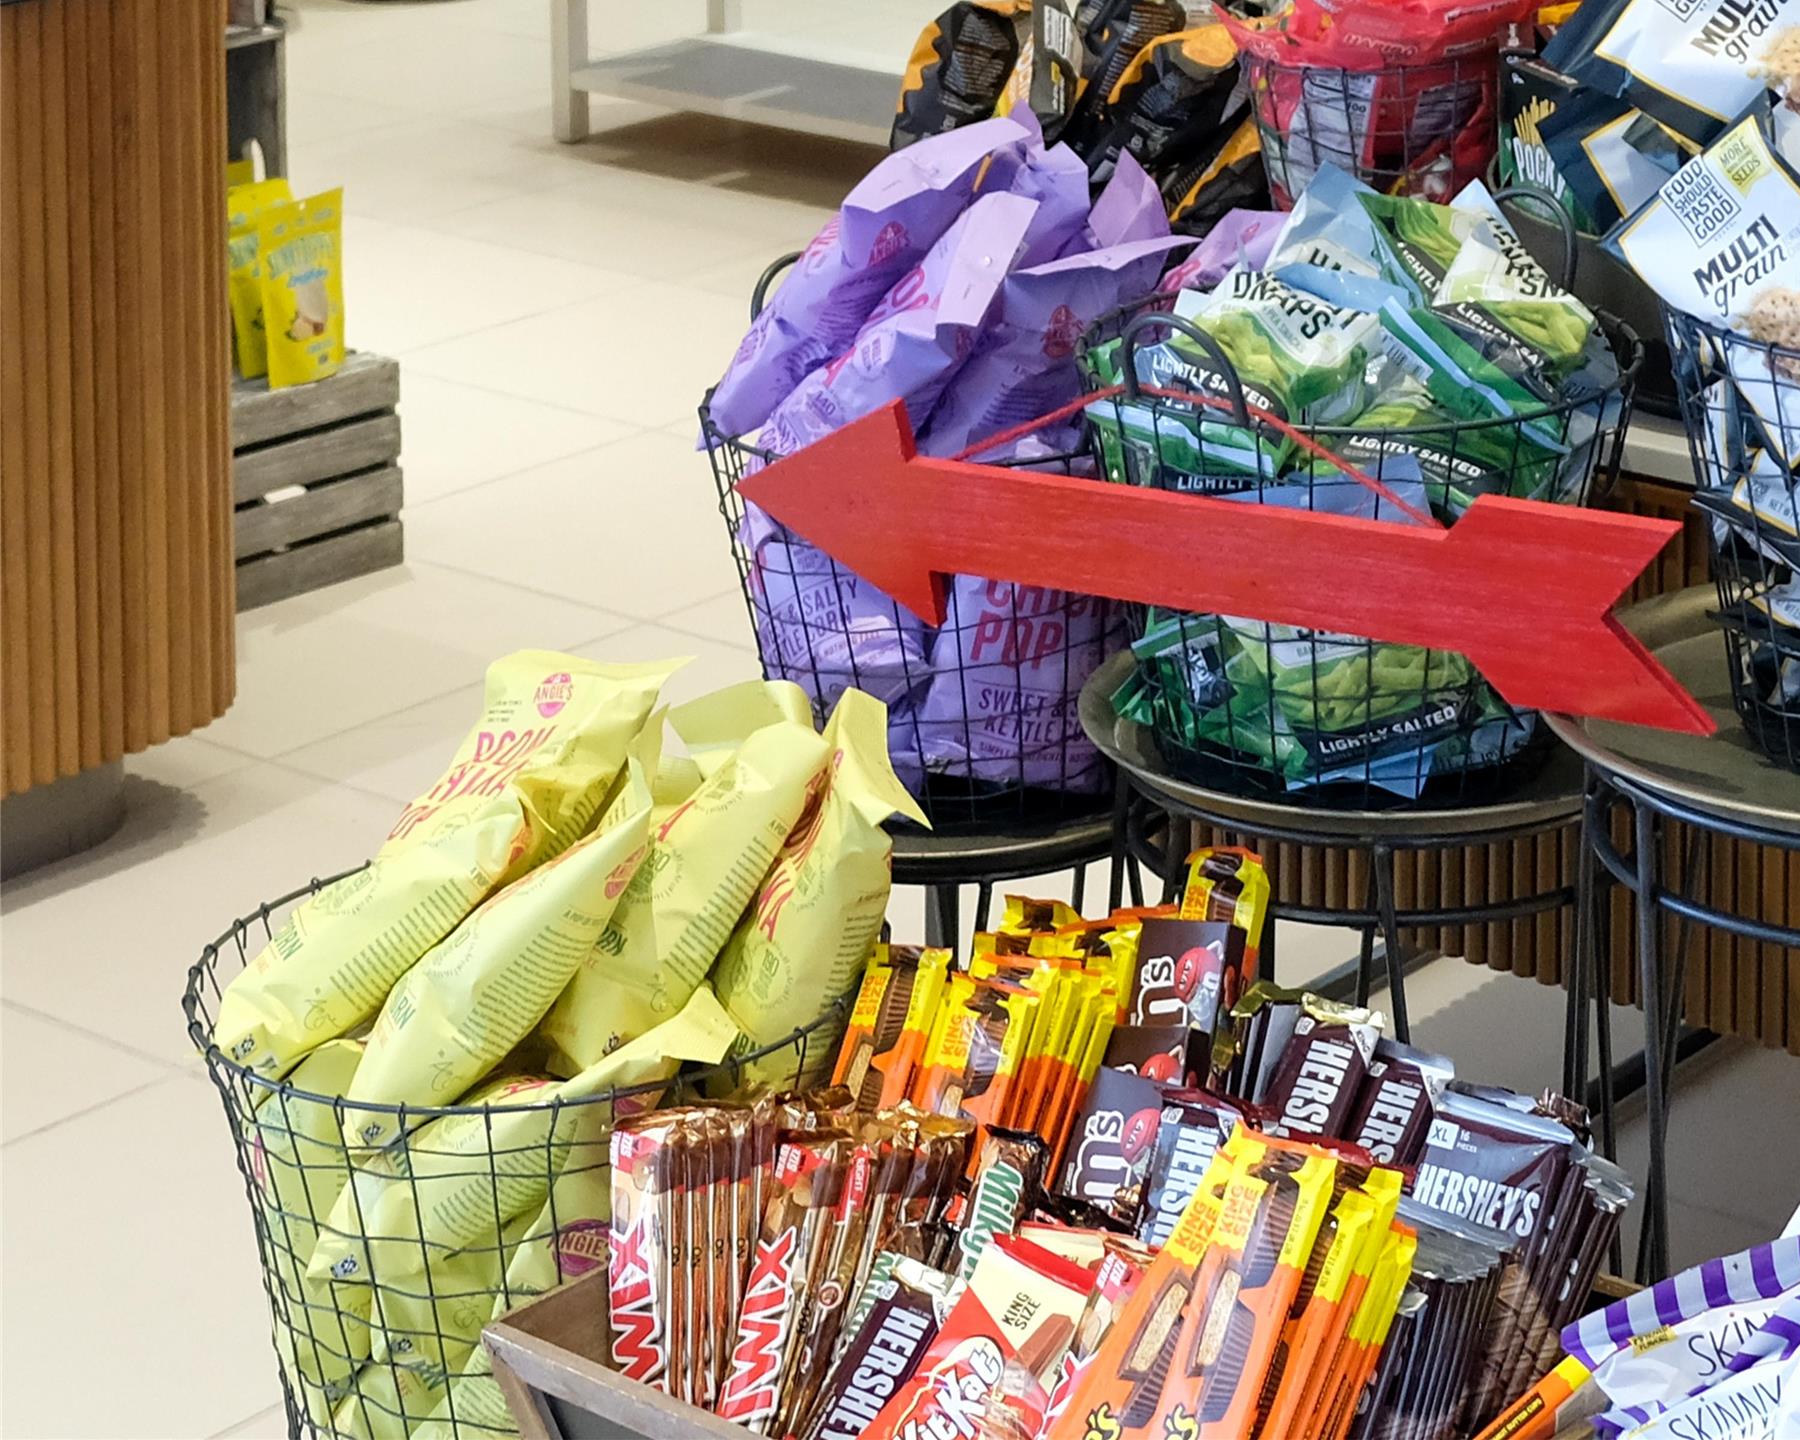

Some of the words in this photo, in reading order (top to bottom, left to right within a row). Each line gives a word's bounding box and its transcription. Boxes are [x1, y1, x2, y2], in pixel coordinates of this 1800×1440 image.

[1663, 160, 1704, 204] FOOD
[1674, 174, 1713, 214] SHOULD
[1684, 187, 1723, 225] TASTE
[1694, 199, 1734, 241] GOOD
[1692, 213, 1780, 298] MULTI
[1714, 244, 1788, 318] grain
[1209, 370, 1274, 411] SATED
[1349, 435, 1421, 457] LIGHTLY
[1418, 446, 1487, 478] SALTED
[970, 611, 1066, 671] POP
[533, 683, 574, 703] ANGIE'S
[978, 688, 1045, 713] SWEET
[1319, 727, 1389, 755] LIGHTLY
[1391, 705, 1458, 735] SALTED
[1431, 1127, 1449, 1143] XL
[1460, 1130, 1471, 1141] 16
[1220, 1184, 1245, 1234] KING
[1230, 1185, 1261, 1238] SIZE
[1412, 1162, 1541, 1238] HERSHEY'S
[1174, 1198, 1209, 1248] KING
[1189, 1204, 1221, 1254] SIZE
[609, 1217, 661, 1382] WIX
[1002, 1292, 1032, 1328] KING
[1013, 1298, 1042, 1331] SIZE
